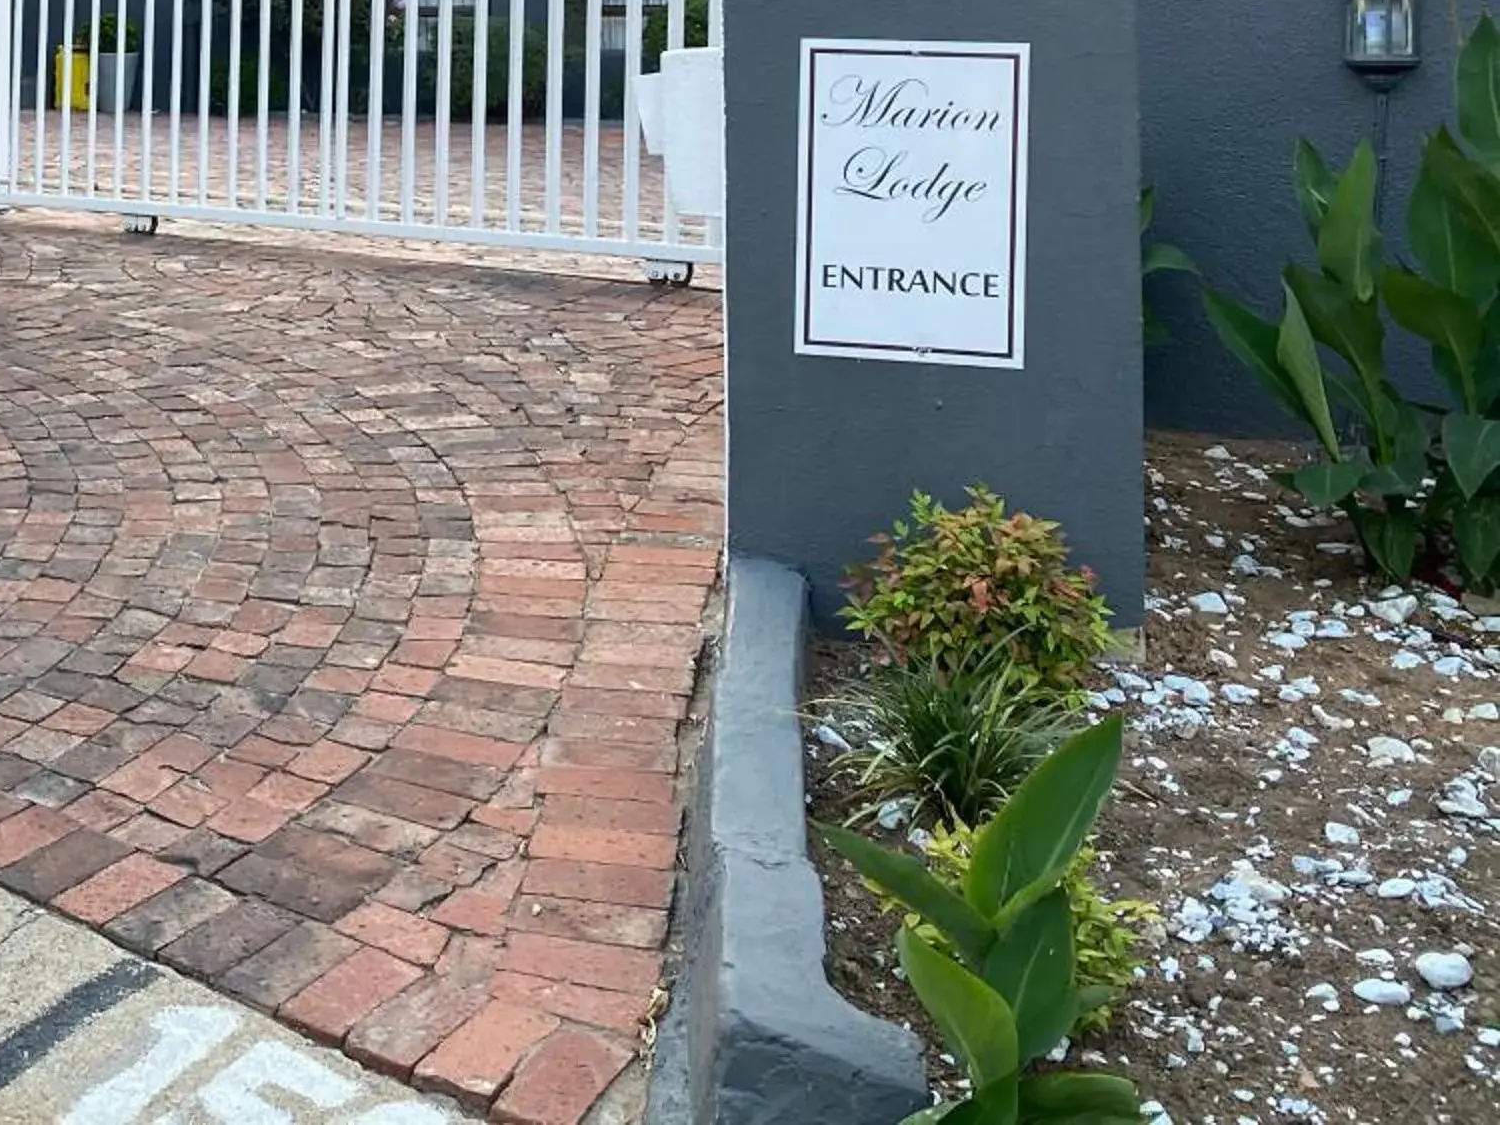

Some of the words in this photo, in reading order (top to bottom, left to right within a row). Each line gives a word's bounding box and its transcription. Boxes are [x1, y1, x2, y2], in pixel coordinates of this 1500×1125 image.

[821, 74, 1000, 132] Marion
[832, 146, 988, 224] Lodge
[822, 264, 1000, 298] ENTRANCE
